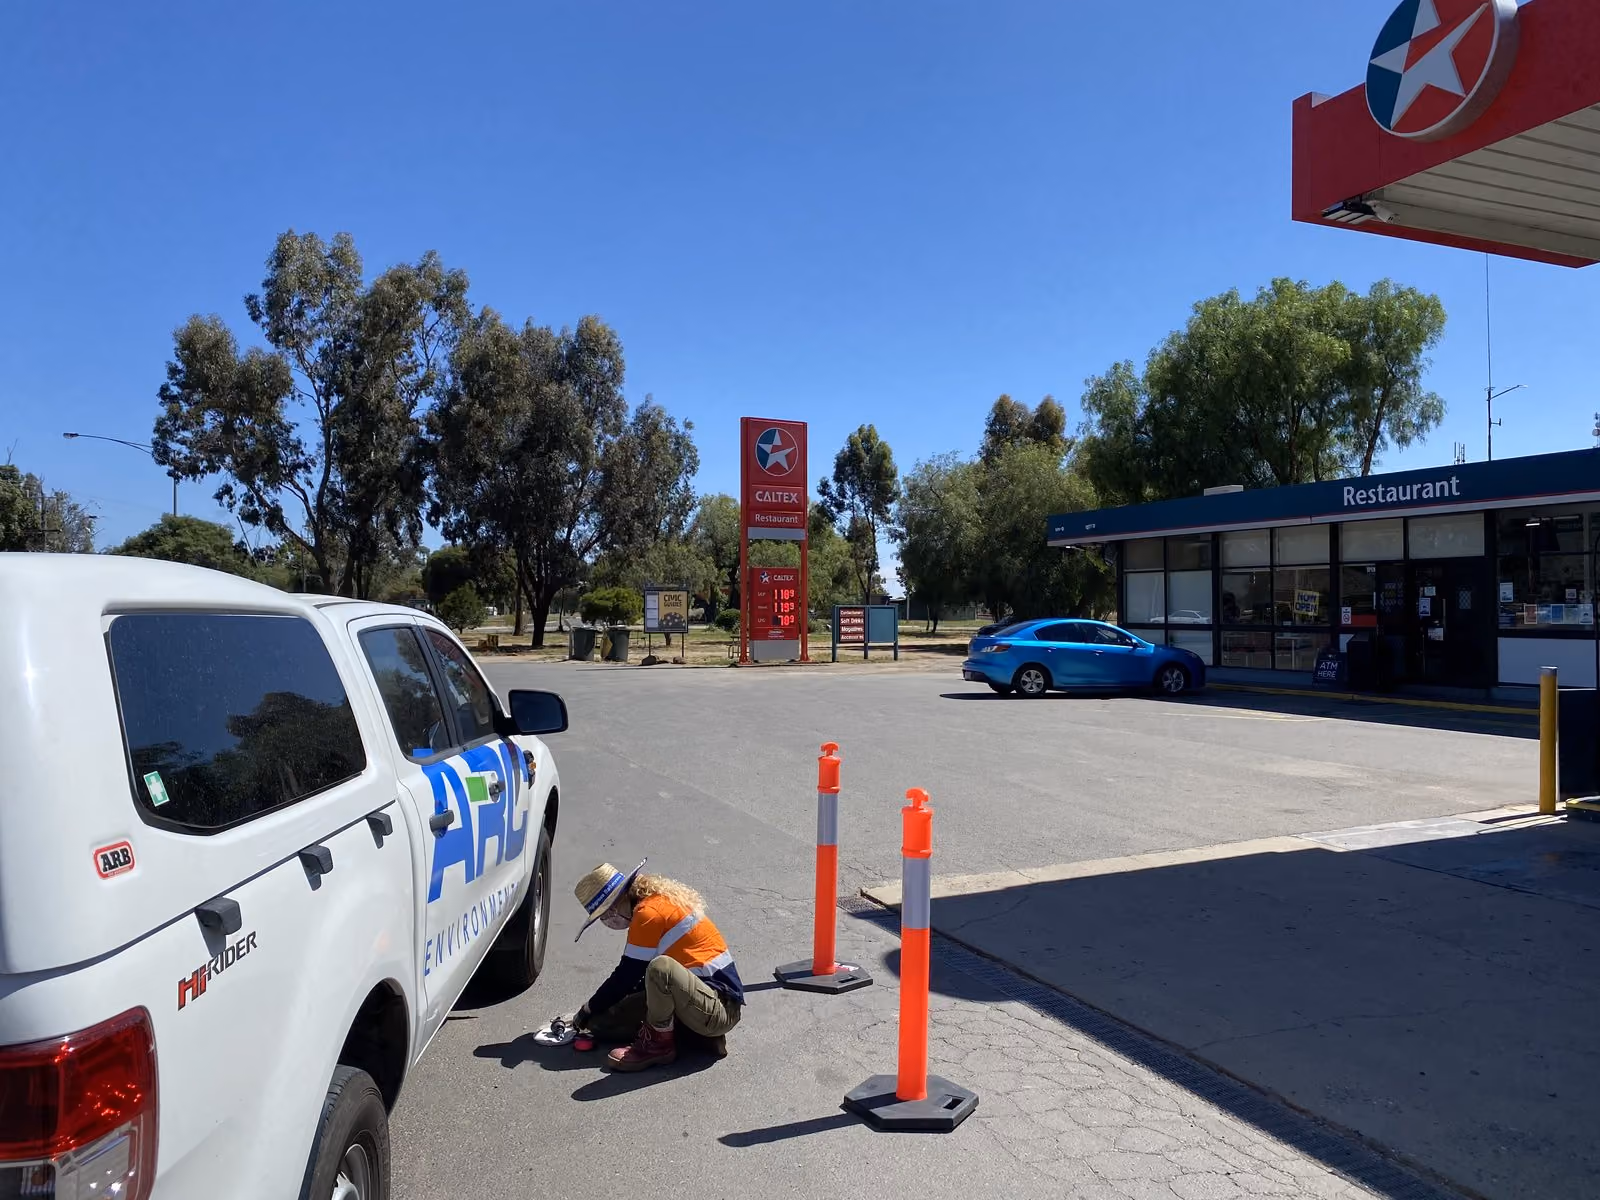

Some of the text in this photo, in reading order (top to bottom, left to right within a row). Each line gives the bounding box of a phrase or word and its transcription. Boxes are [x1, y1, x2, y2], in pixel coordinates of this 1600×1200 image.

[755, 490, 799, 503] CALTEX
[1343, 476, 1460, 506] Restaurant
[755, 513, 799, 523] Restaurant
[1295, 602, 1318, 612] OPEN
[1319, 661, 1338, 670] ATM
[1317, 670, 1336, 678] HERE
[421, 742, 529, 904] ARC
[100, 847, 131, 872] ARB
